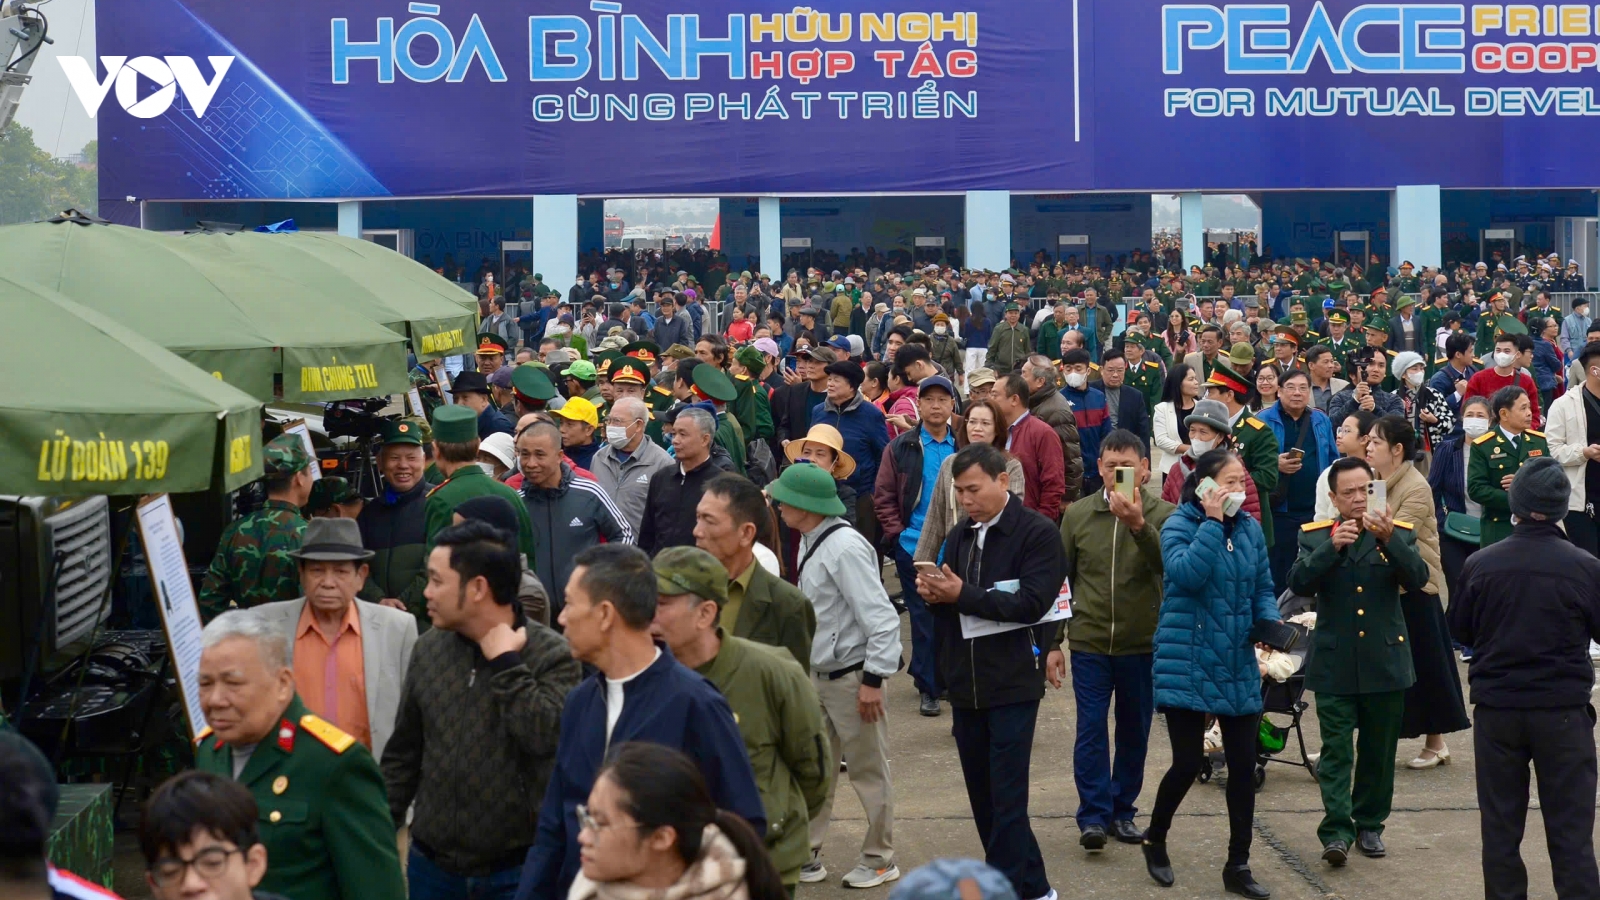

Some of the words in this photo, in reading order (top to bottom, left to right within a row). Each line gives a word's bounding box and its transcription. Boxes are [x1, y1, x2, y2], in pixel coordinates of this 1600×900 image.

[330, 1, 508, 84] HÒA
[529, 0, 746, 81] BÌNH
[750, 6, 852, 43] HỮU
[859, 12, 978, 47] NGHỊ
[1161, 1, 1466, 75] PEACE
[1472, 4, 1600, 37] FRIE
[751, 47, 855, 85] HỢP
[874, 41, 978, 79] TÁC
[1472, 43, 1600, 74] COOP
[532, 86, 675, 122] CÙNG
[684, 85, 822, 120] PHÁT
[827, 79, 978, 120] TRIỂN
[1164, 88, 1255, 117] FOR
[1265, 87, 1456, 117] MUTUAL
[38, 429, 70, 482] LỮ
[71, 431, 129, 482] ĐOÀN
[130, 440, 169, 480] 139
